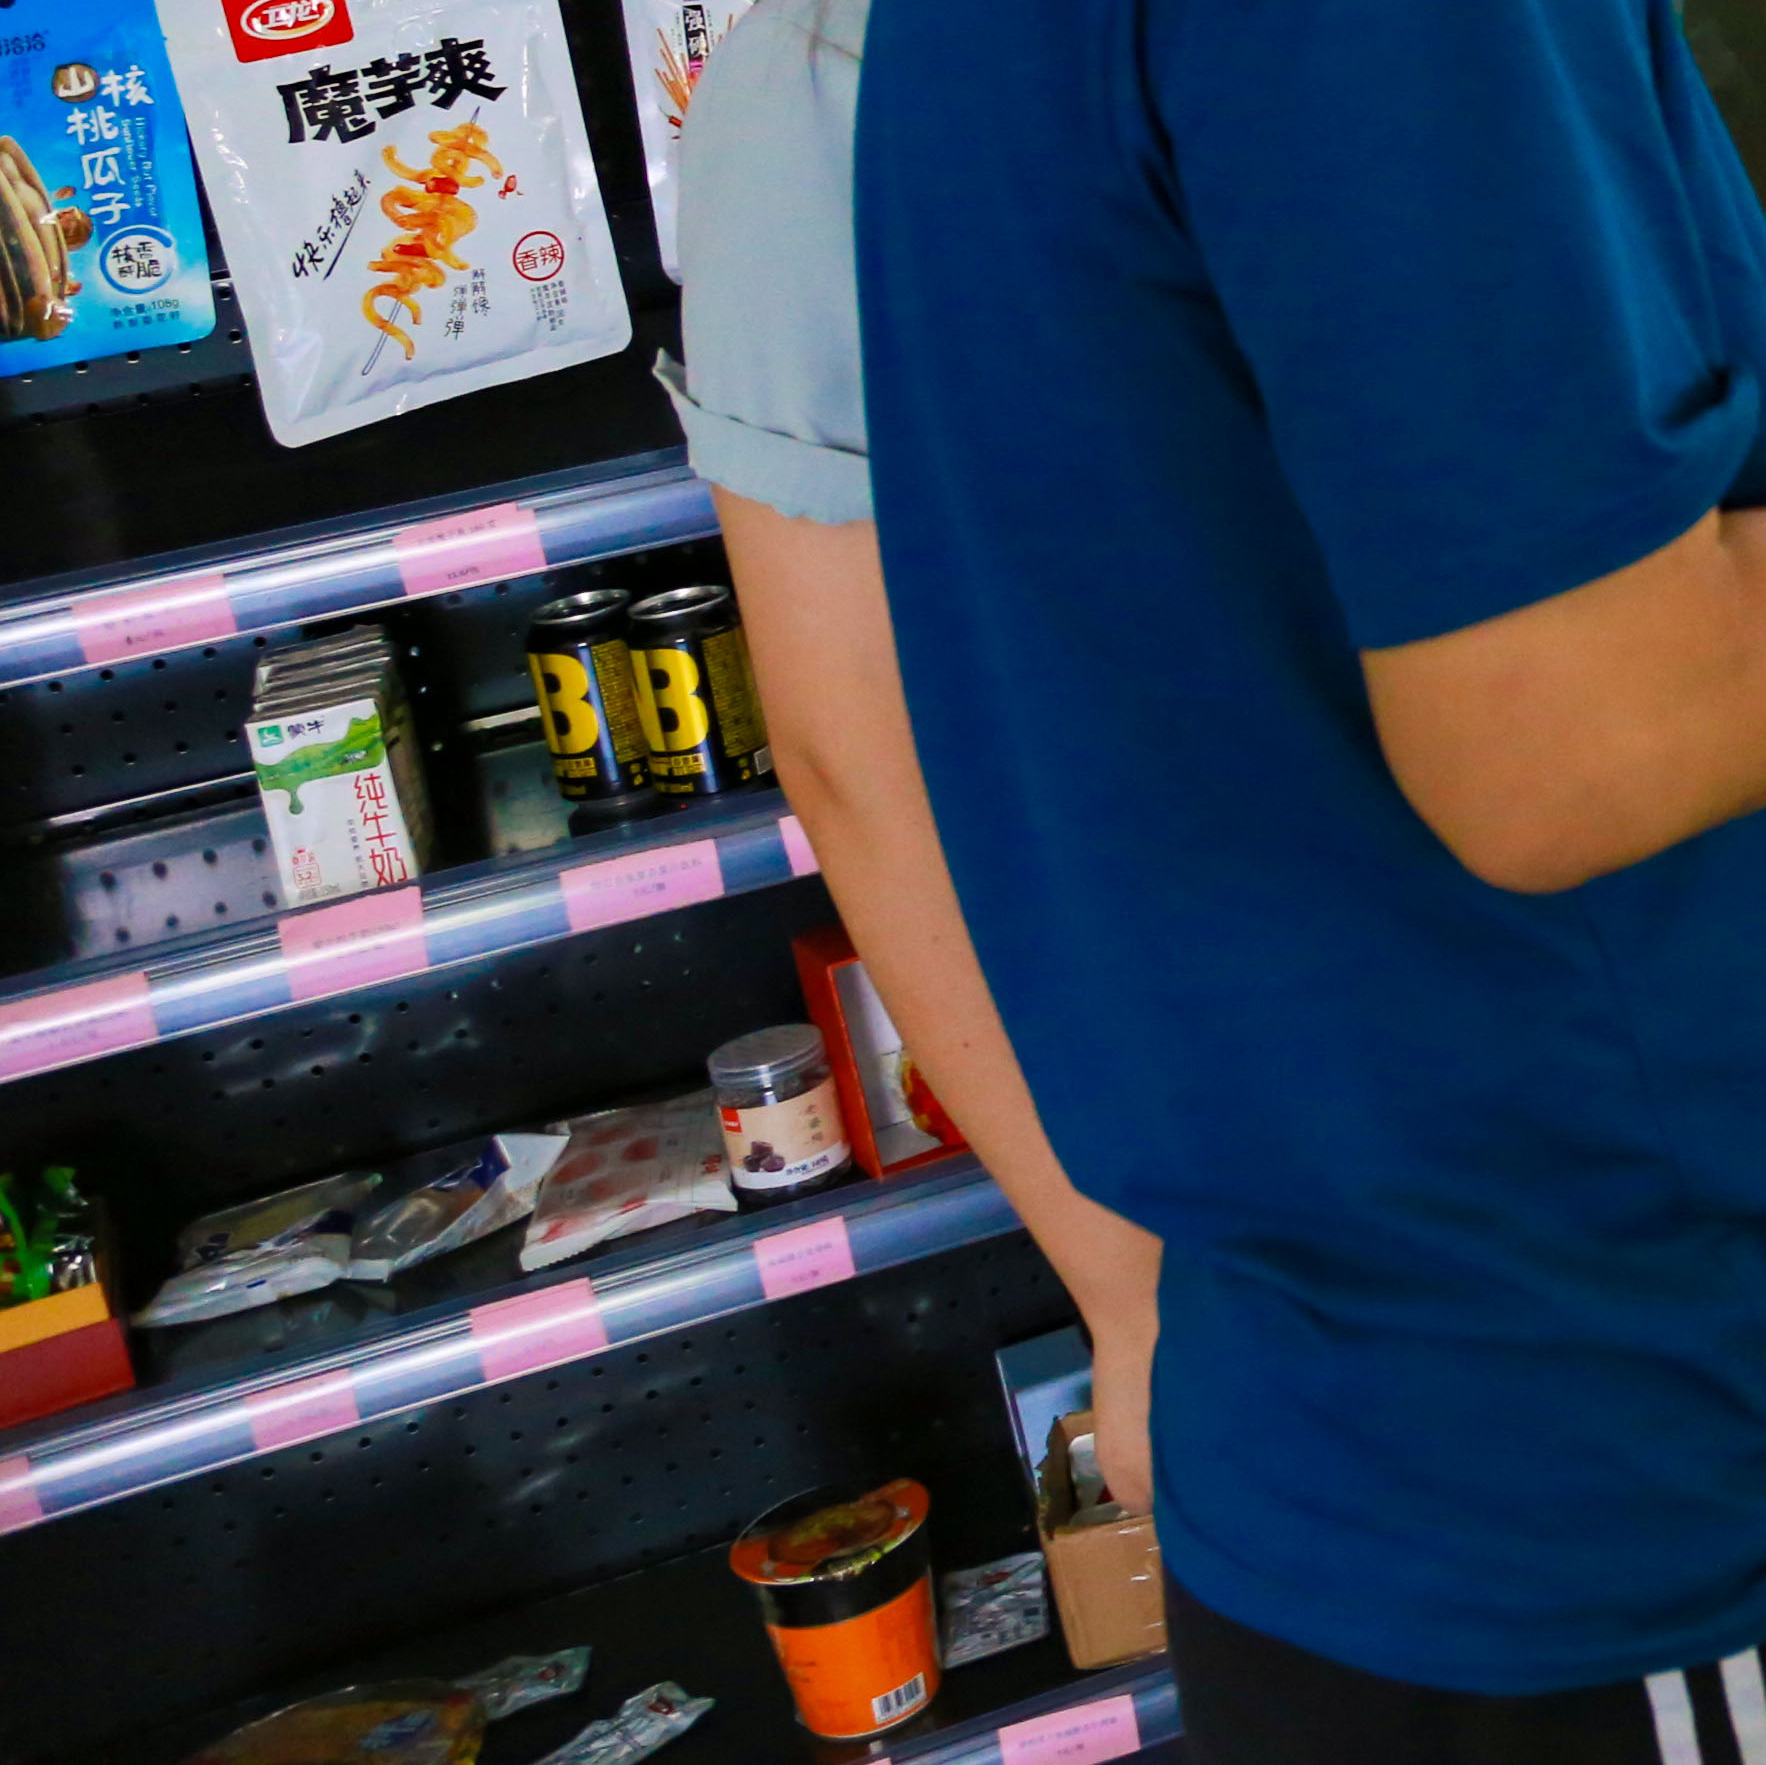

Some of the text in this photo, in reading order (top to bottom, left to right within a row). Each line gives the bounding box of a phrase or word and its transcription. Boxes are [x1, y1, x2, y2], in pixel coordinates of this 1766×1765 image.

[276, 37, 508, 144] 魔芋爽
[516, 243, 564, 273] 香辣
[287, 718, 324, 739] 蒙牛
[353, 772, 409, 886] 纯牛奶
